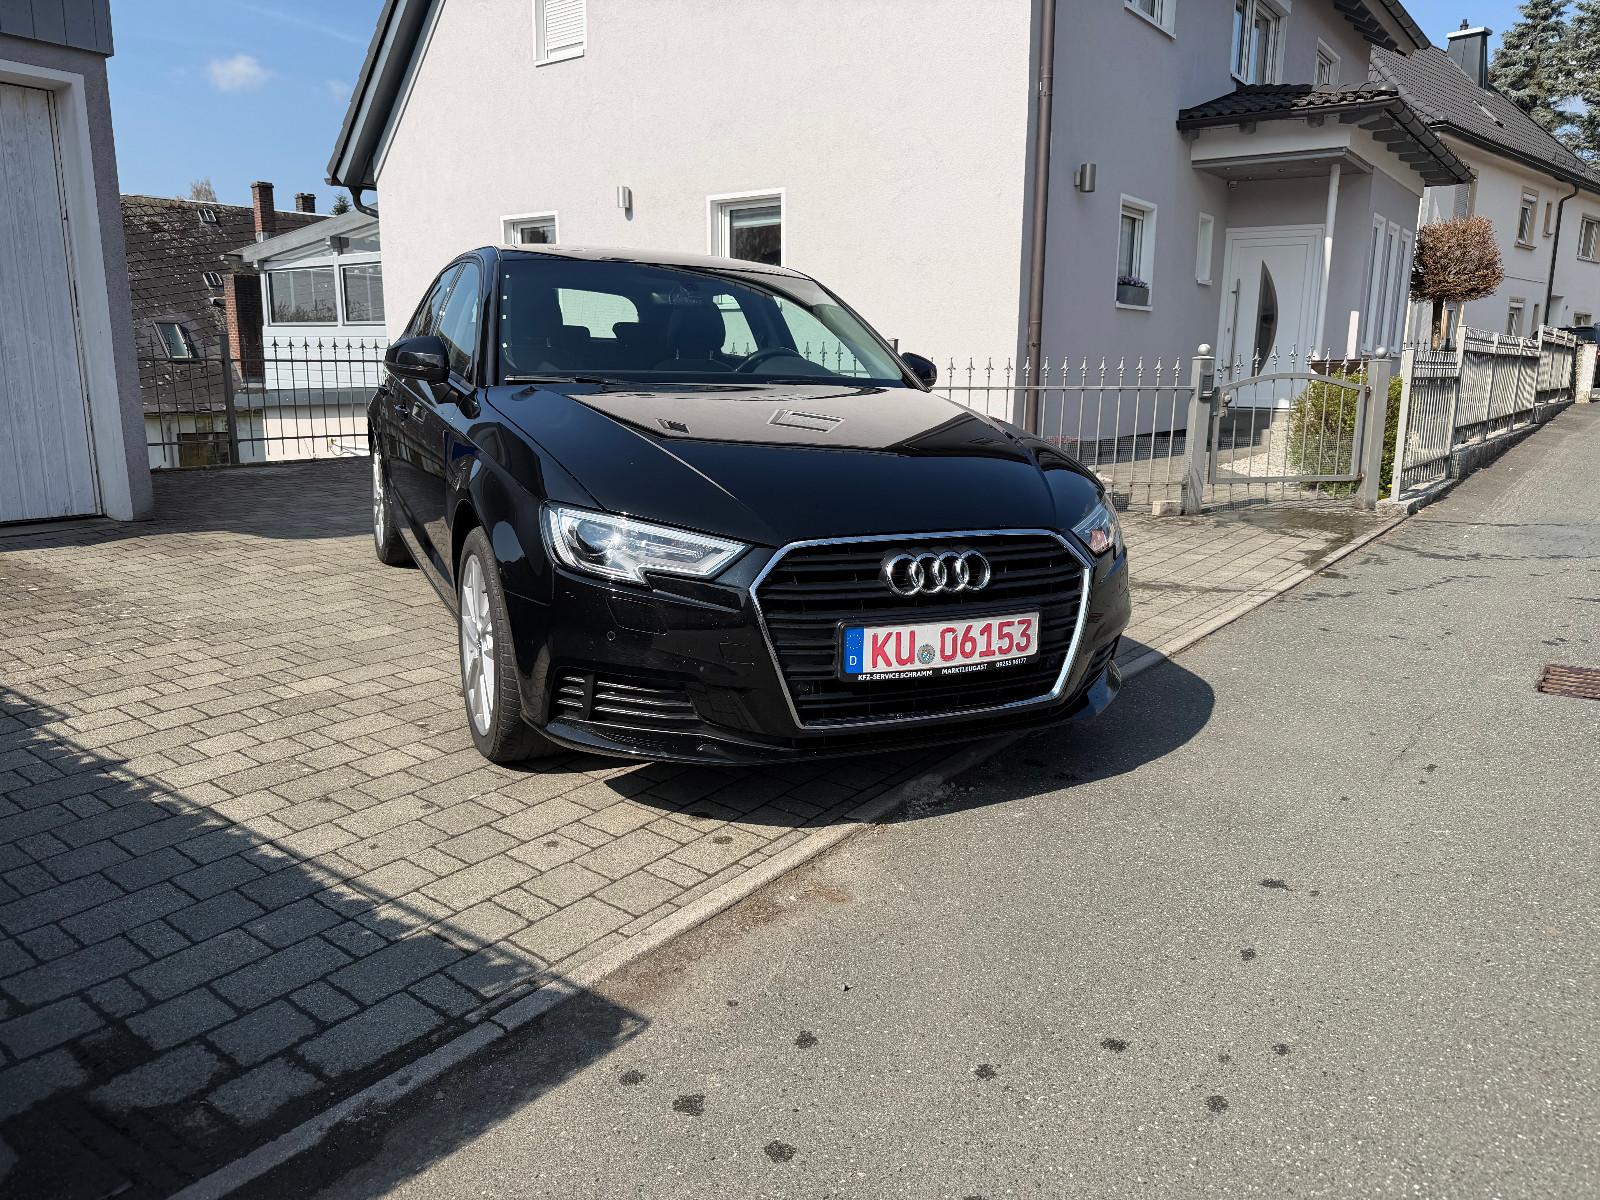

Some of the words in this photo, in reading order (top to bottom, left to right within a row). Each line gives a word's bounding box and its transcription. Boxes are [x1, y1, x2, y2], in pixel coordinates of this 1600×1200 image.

[871, 630, 916, 668] KU
[939, 618, 1032, 662] 06153
[850, 655, 857, 666] D
[858, 673, 900, 682] KFZ-SERVICE
[900, 670, 933, 680] SCHRAMM
[942, 664, 988, 675] MARKTLEUGAST
